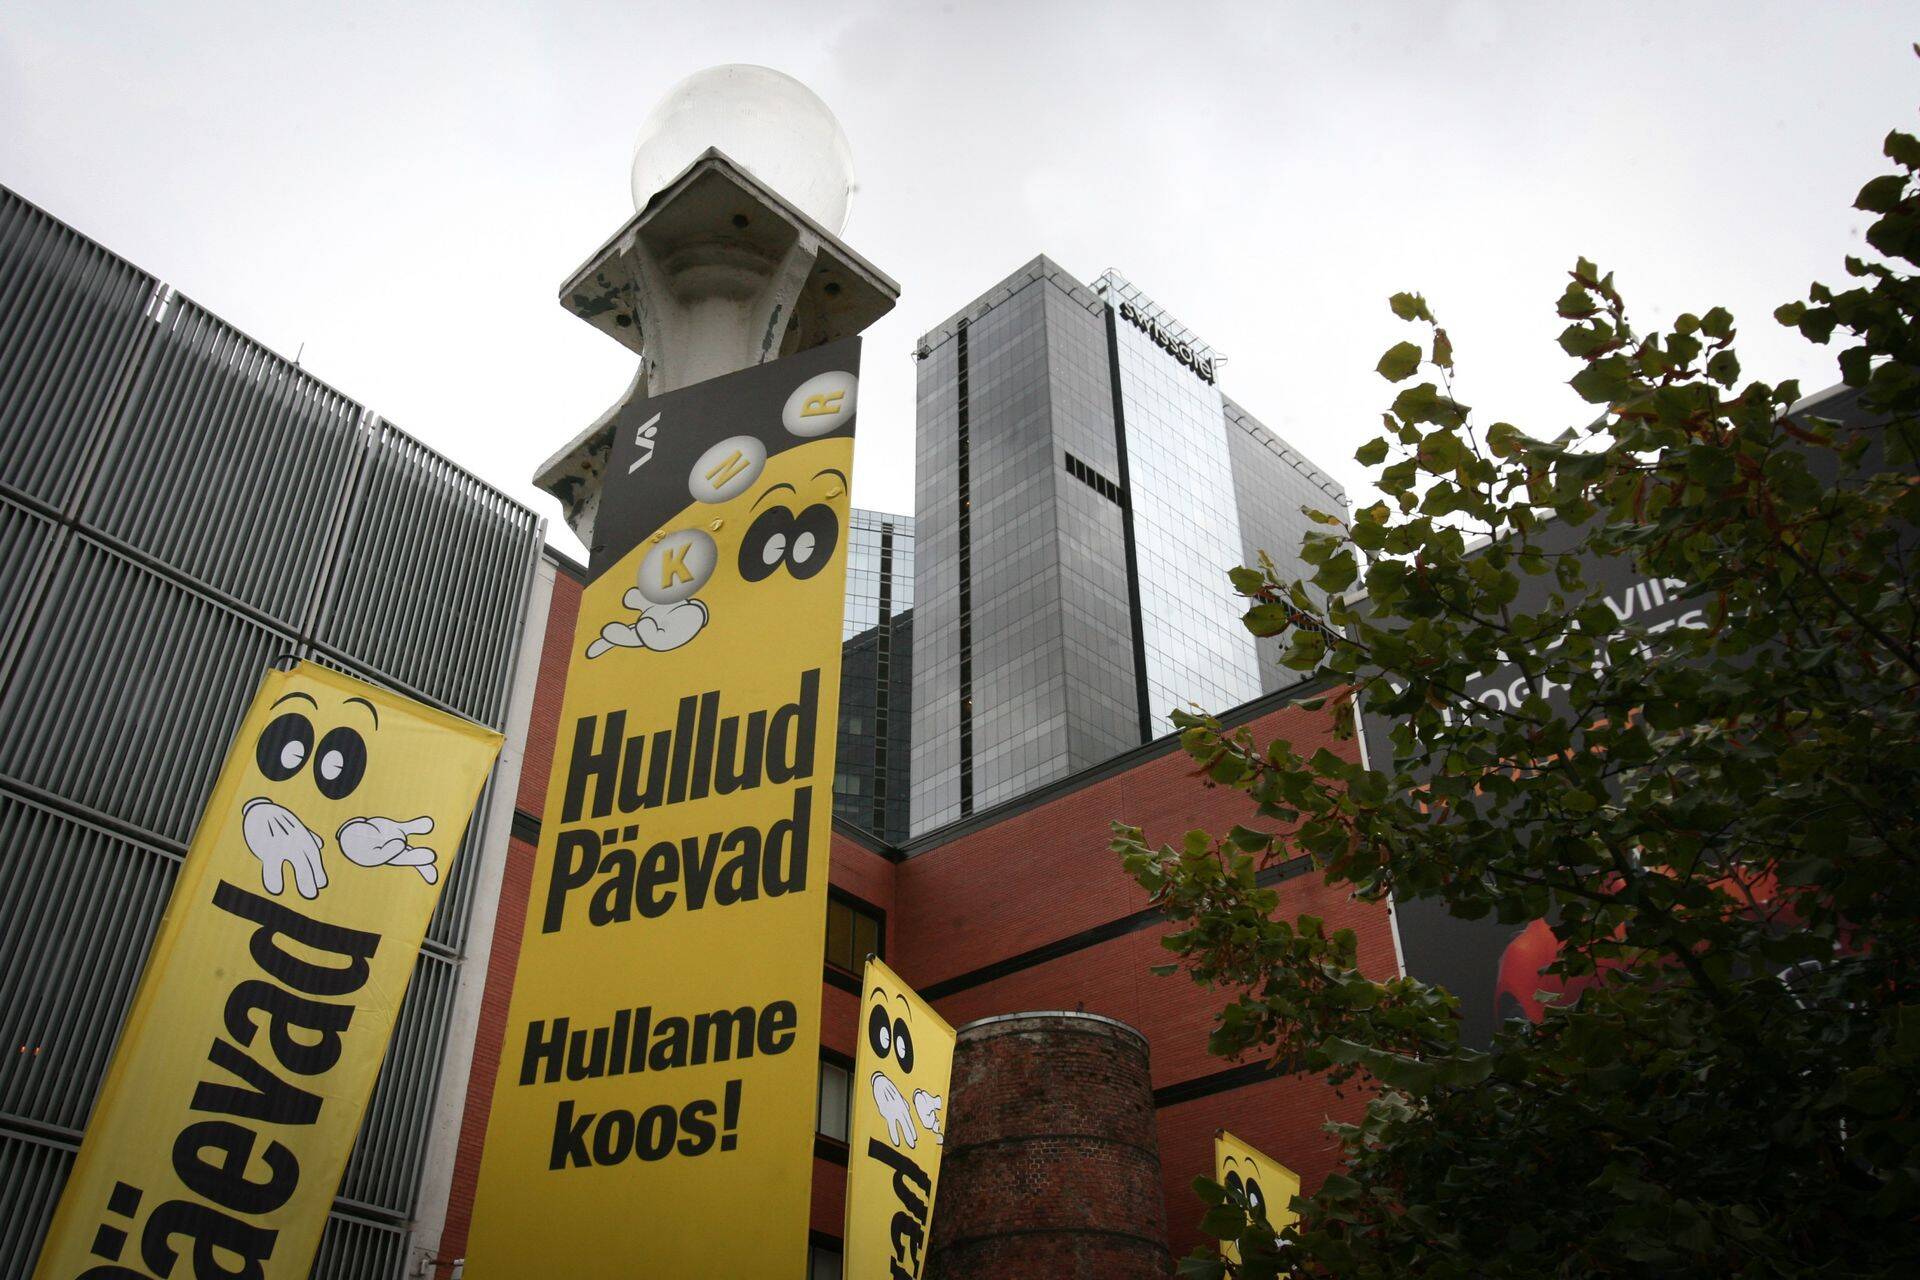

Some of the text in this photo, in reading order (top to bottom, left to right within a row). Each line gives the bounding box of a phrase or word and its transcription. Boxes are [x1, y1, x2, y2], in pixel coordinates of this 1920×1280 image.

[800, 390, 845, 418] R
[662, 542, 695, 590] K
[560, 668, 821, 825] Hullud
[542, 786, 813, 934] Päevad
[74, 879, 382, 1280] äevad
[519, 1000, 798, 1087] Hullame
[548, 1080, 743, 1170] koos!
